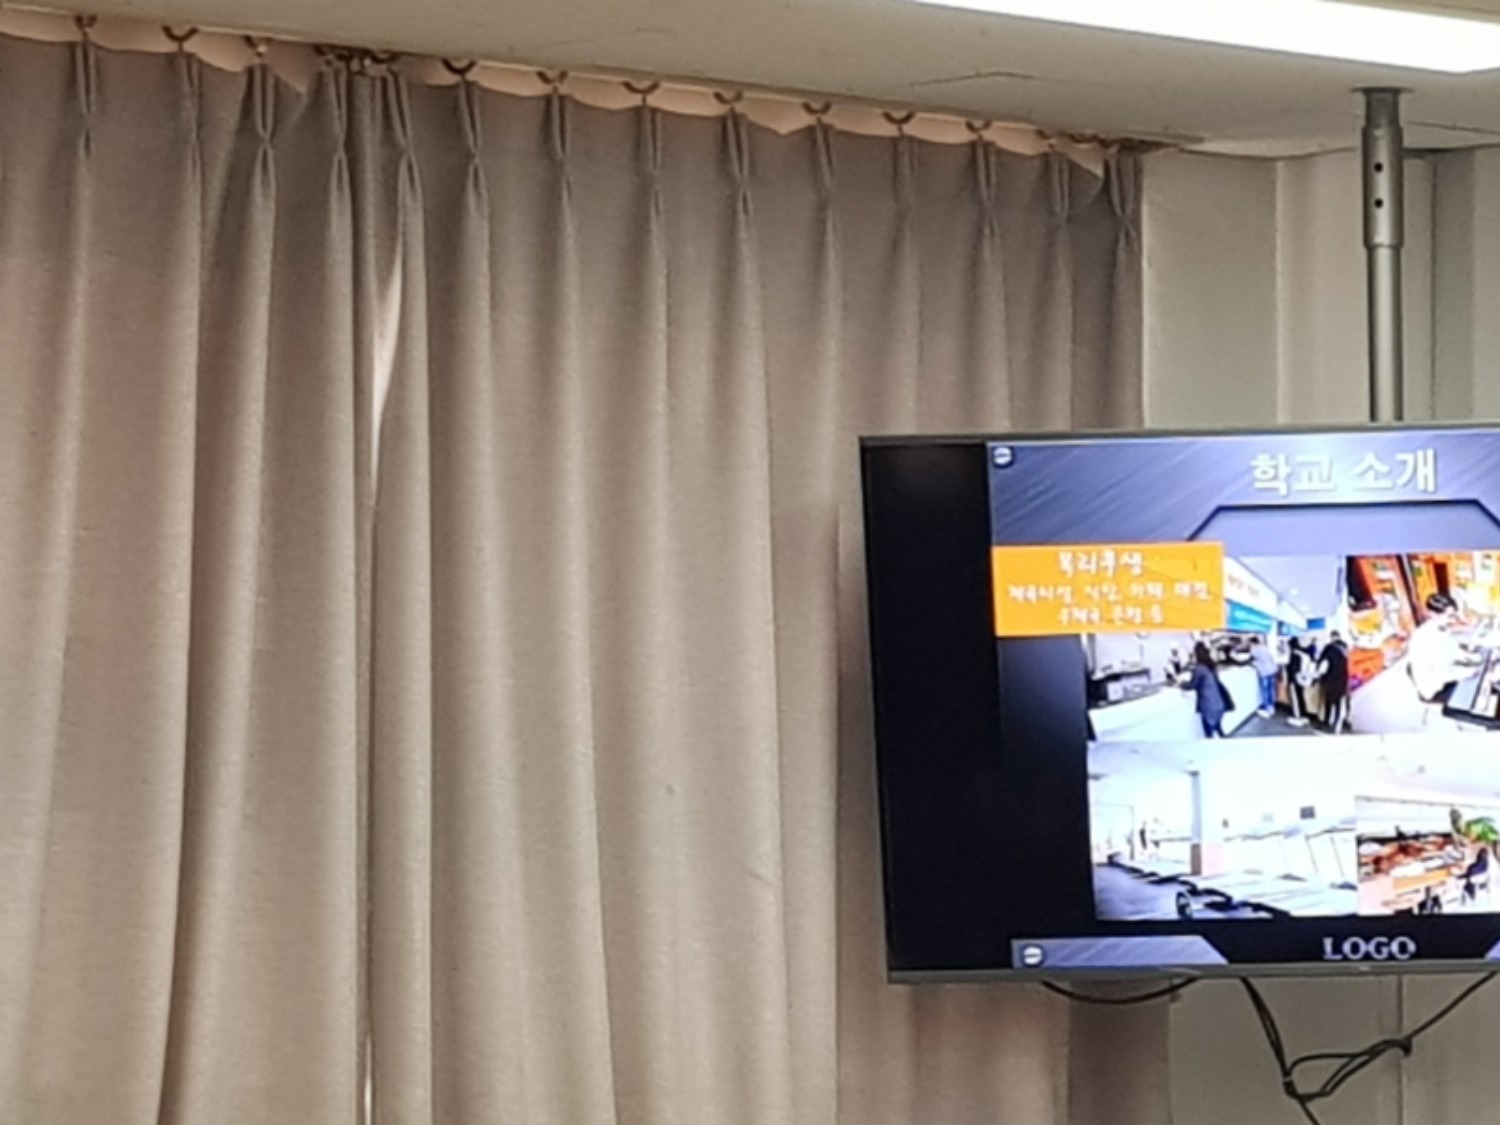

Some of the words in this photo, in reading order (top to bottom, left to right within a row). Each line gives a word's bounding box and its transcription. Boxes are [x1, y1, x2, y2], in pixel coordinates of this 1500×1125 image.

[1251, 453, 1337, 496] 학교
[1352, 448, 1436, 492] 소개
[1322, 936, 1416, 960] LOGO
